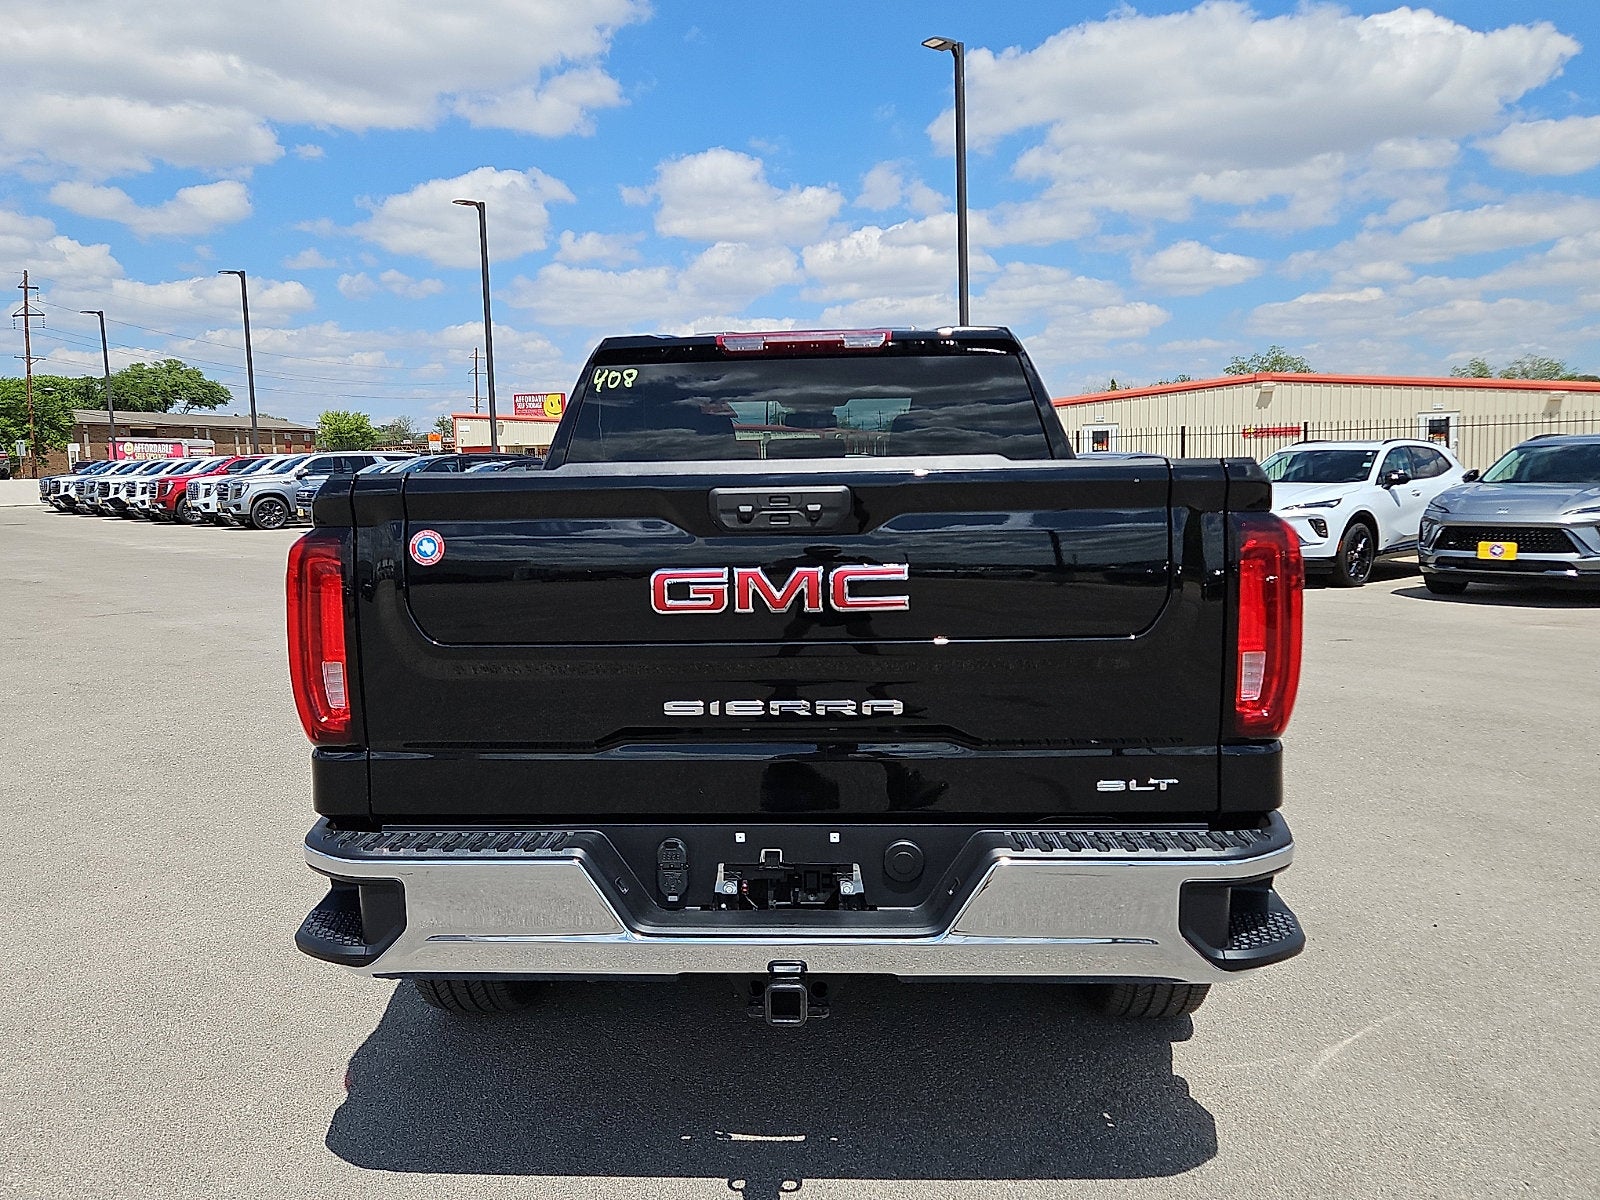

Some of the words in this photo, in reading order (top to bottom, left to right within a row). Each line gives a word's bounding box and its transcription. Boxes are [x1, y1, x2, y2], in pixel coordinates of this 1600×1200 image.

[593, 368, 638, 392] 408
[134, 443, 174, 454] AFFORDABLE
[650, 563, 910, 615] GMC
[663, 699, 904, 717] SIERRA
[1096, 777, 1180, 792] SLT
